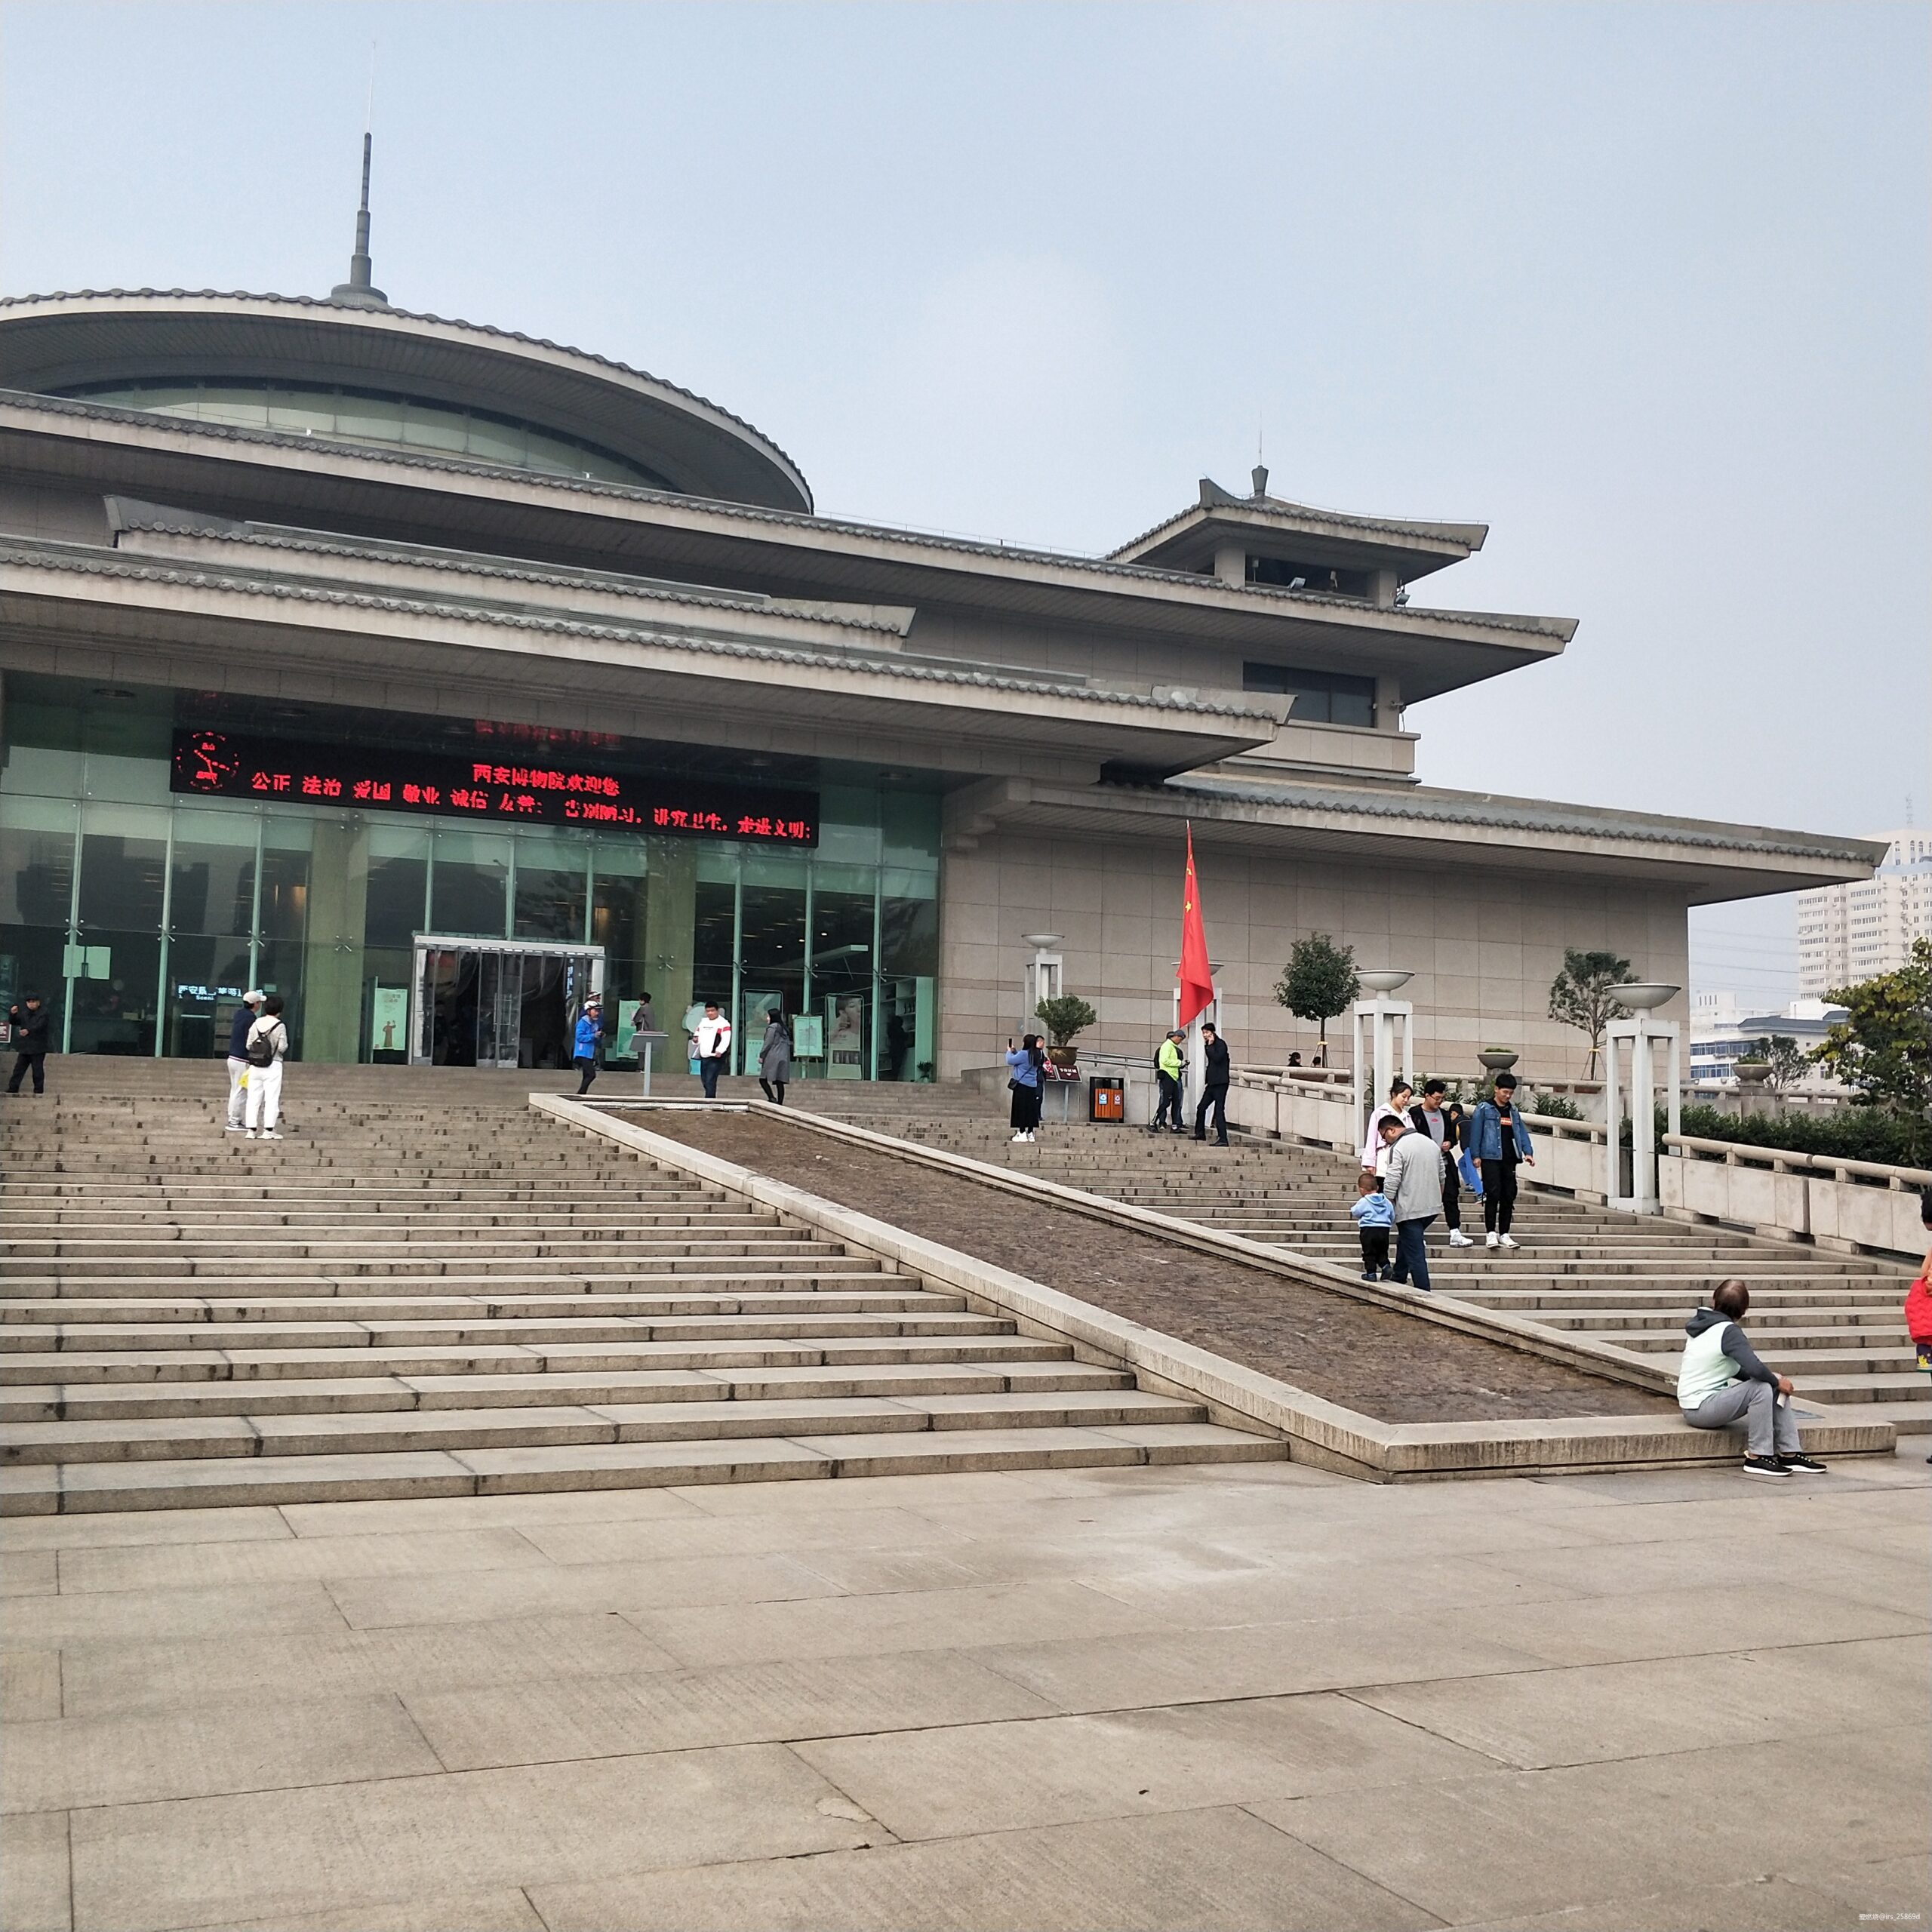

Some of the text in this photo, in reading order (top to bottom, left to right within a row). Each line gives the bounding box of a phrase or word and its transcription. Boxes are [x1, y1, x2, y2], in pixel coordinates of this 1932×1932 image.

[251, 771, 292, 792] 公正
[301, 774, 343, 797] 法治
[449, 788, 489, 810] 诚信
[472, 763, 620, 798] 西安博物院欢迎您
